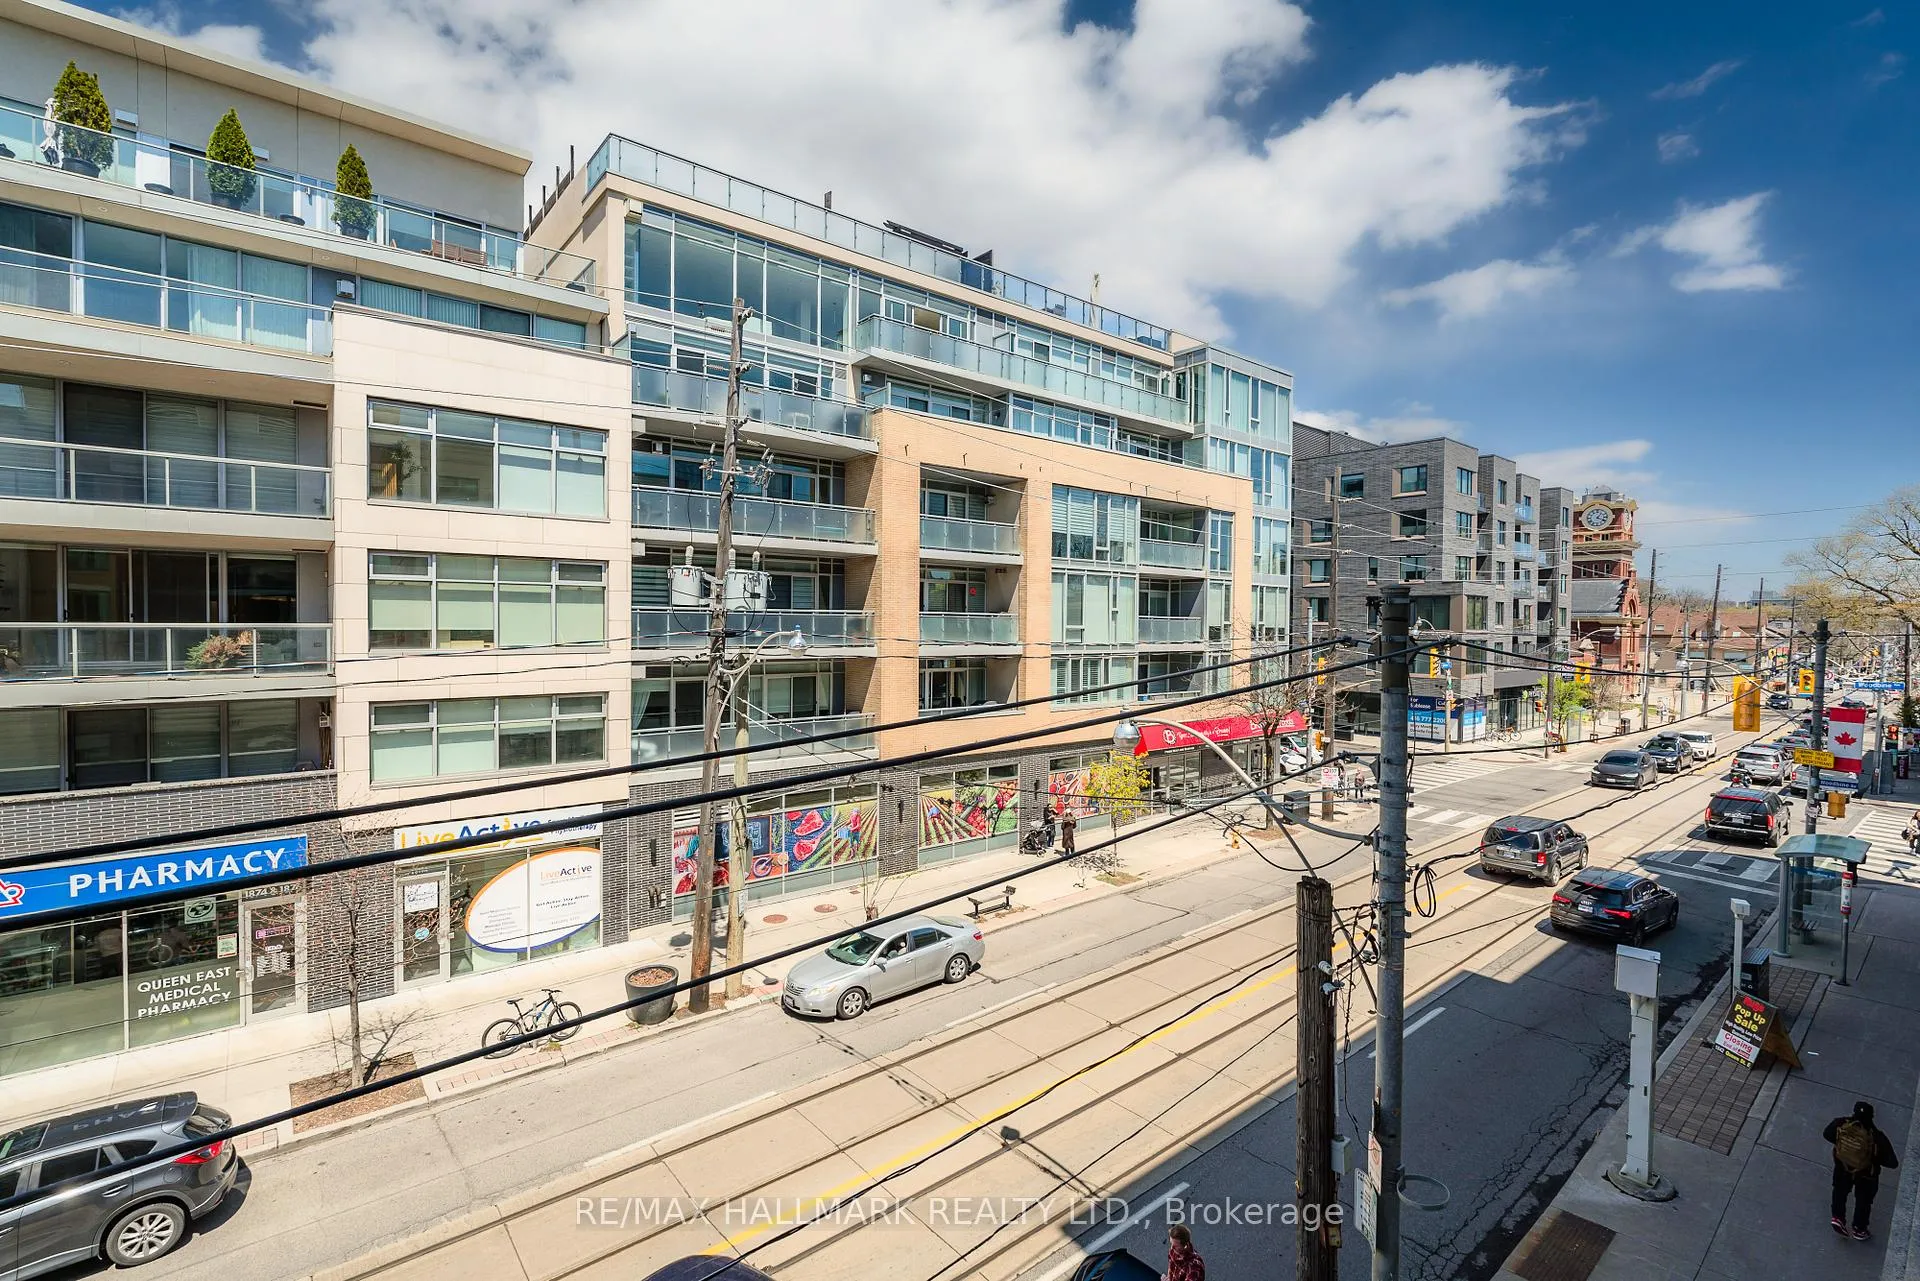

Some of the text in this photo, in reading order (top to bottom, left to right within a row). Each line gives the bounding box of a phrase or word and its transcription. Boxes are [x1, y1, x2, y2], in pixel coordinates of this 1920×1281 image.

[1820, 780, 1849, 788] Woodbine
[69, 848, 285, 897] PHARMACY
[137, 966, 231, 993] QUEEN EAST
[149, 981, 221, 1004] MEDICAL
[137, 991, 232, 1019] PHARMACY
[1734, 1004, 1766, 1025] Pop Up
[1734, 1015, 1759, 1032] Sale
[1724, 1032, 1753, 1053] Closing
[1725, 1050, 1740, 1062] Queen
